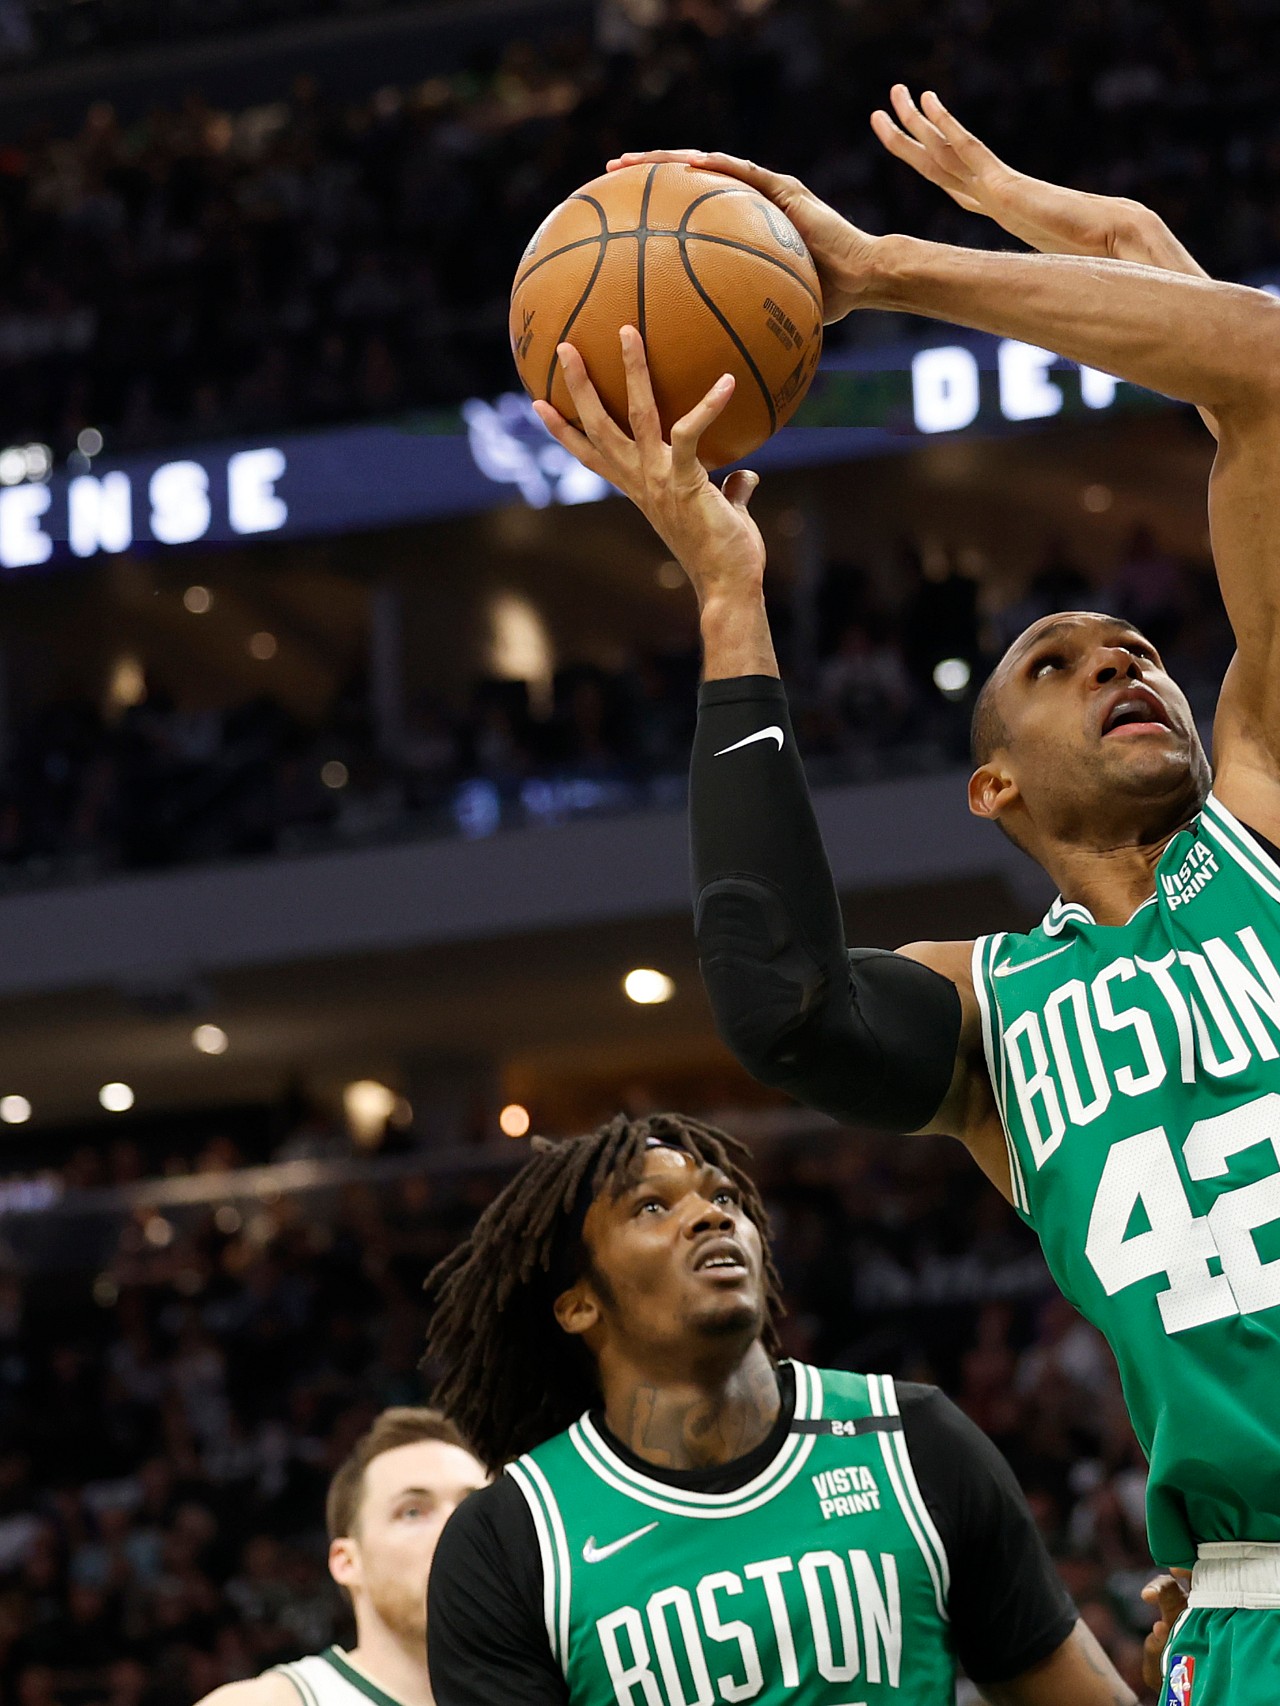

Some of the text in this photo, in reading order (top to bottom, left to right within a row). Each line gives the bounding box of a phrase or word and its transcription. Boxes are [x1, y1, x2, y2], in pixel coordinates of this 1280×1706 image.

[0, 447, 288, 569] ENSE
[1160, 840, 1212, 896] VISTA
[1166, 853, 1219, 912] PRINT
[831, 1420, 856, 1436] 24
[811, 1465, 878, 1500] VISTA
[819, 1490, 881, 1520] PRINT
[596, 1549, 902, 1706] BOSTON
